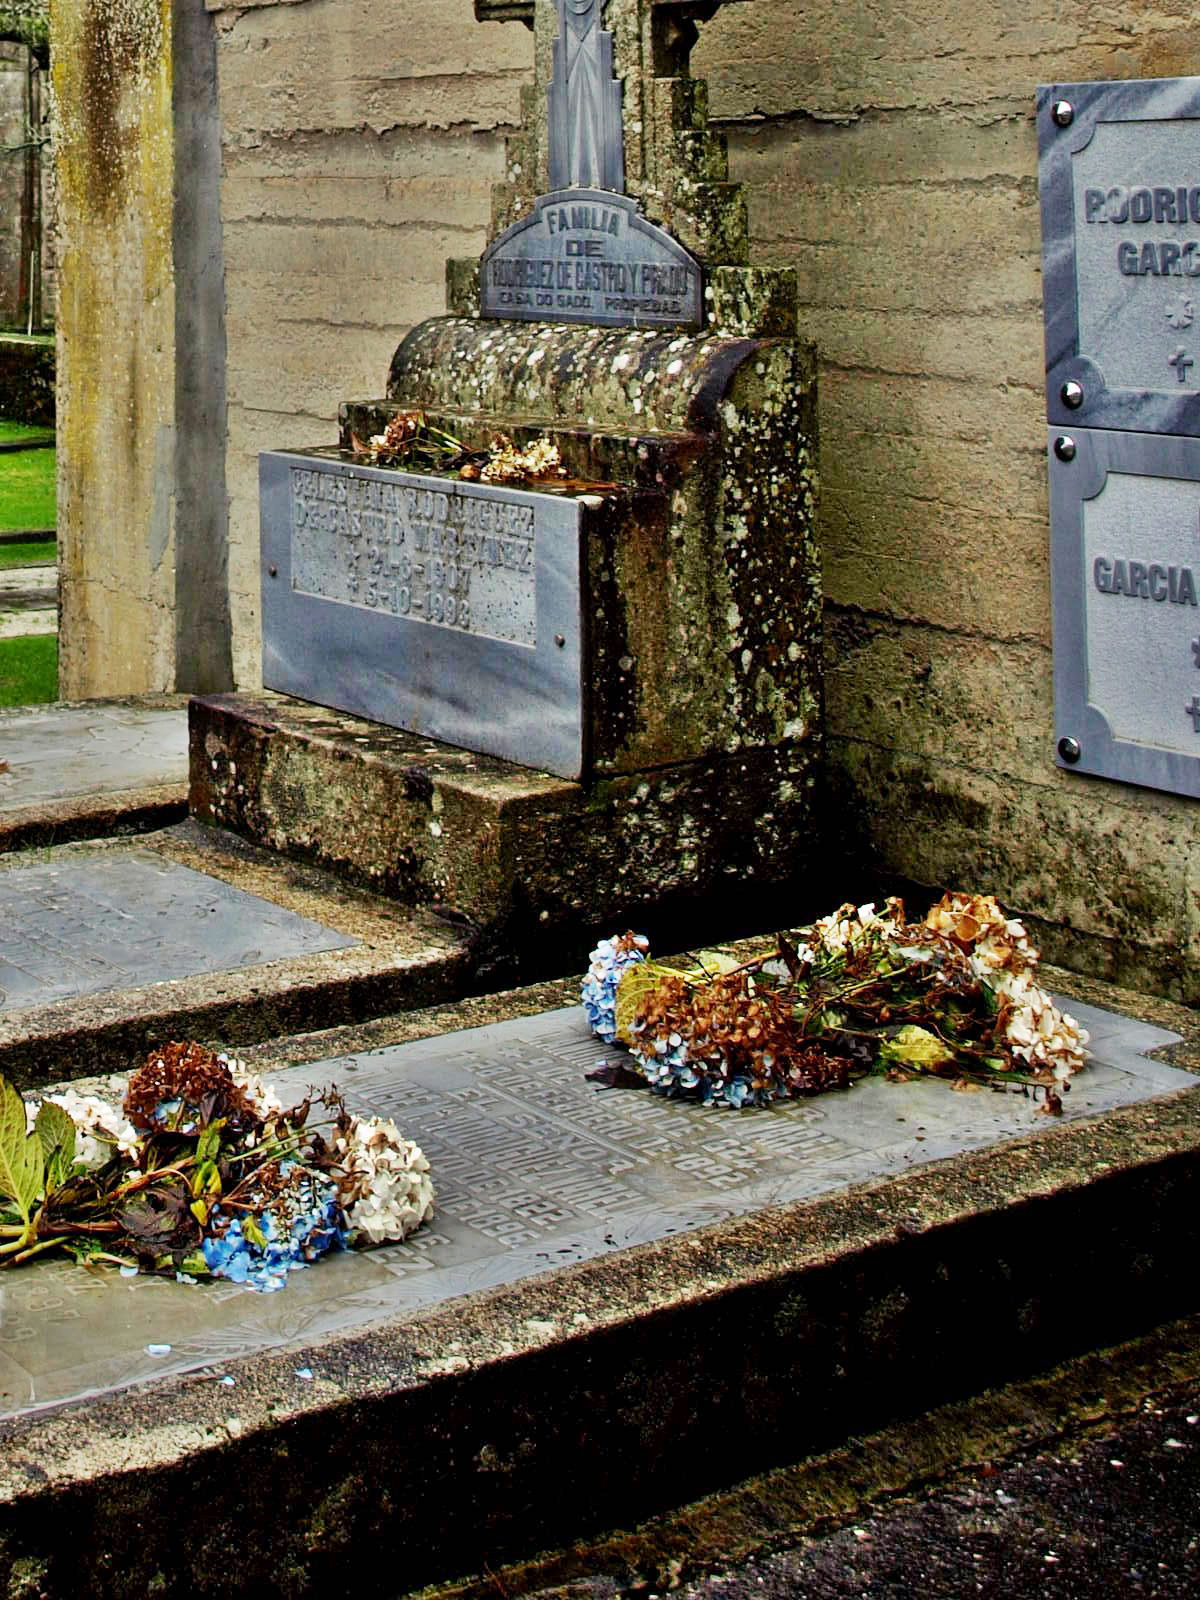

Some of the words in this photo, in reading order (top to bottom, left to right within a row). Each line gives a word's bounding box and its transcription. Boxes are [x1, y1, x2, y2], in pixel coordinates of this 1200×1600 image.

[548, 207, 621, 236] FAMILIA
[566, 240, 604, 256] DE
[558, 261, 573, 290] DE
[575, 262, 626, 293] CASTRO
[628, 263, 640, 293] Y
[1094, 556, 1197, 606] GARCIA
[443, 1086, 509, 1112] EL
